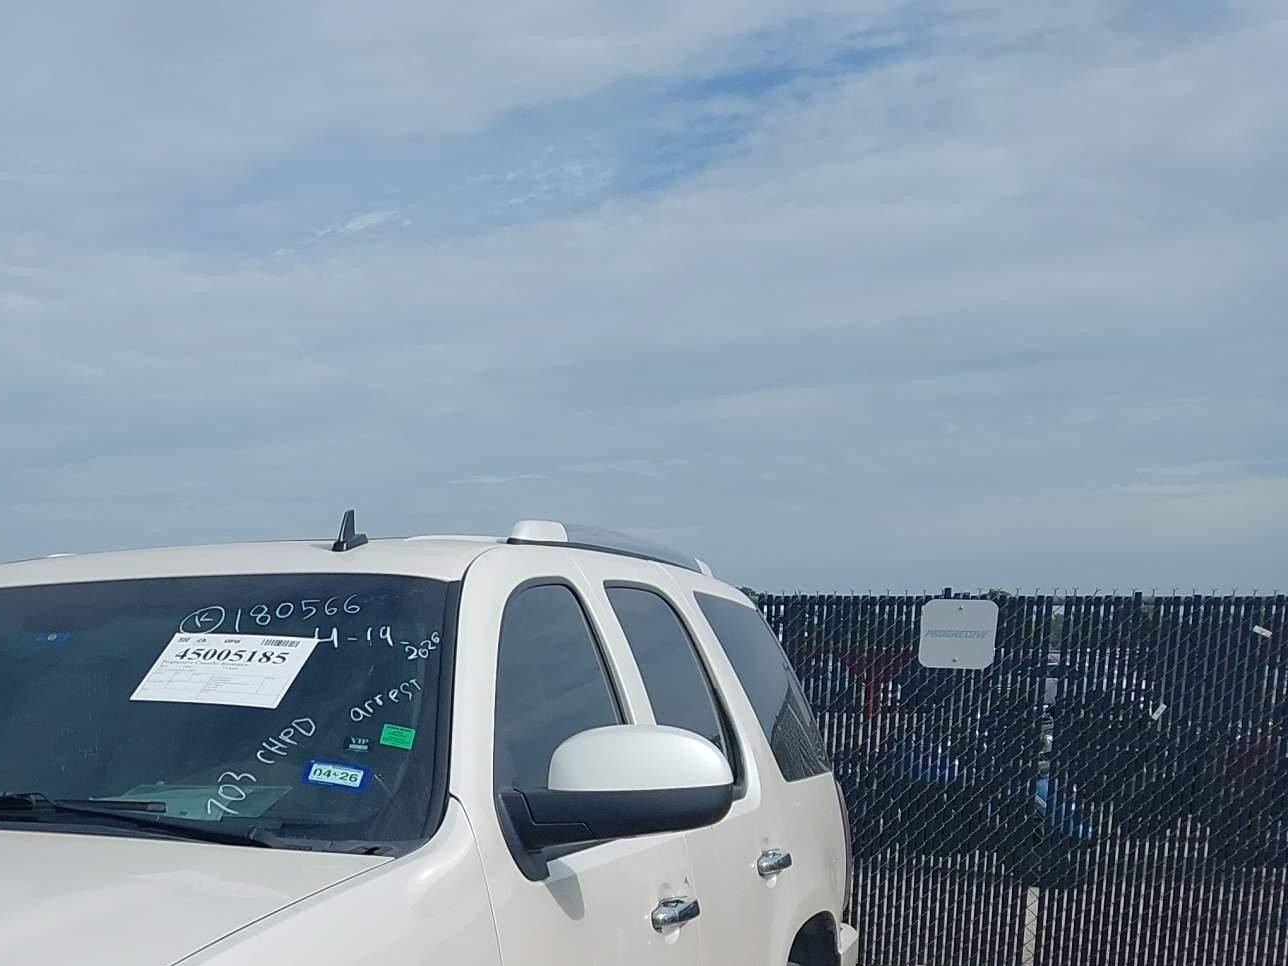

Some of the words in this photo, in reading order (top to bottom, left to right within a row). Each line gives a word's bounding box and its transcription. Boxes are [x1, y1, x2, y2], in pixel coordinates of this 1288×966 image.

[234, 594, 362, 633] 180566
[175, 648, 290, 665] 45005185
[350, 678, 423, 722] arrest
[255, 717, 317, 764] CHPD
[349, 737, 370, 745] VIP
